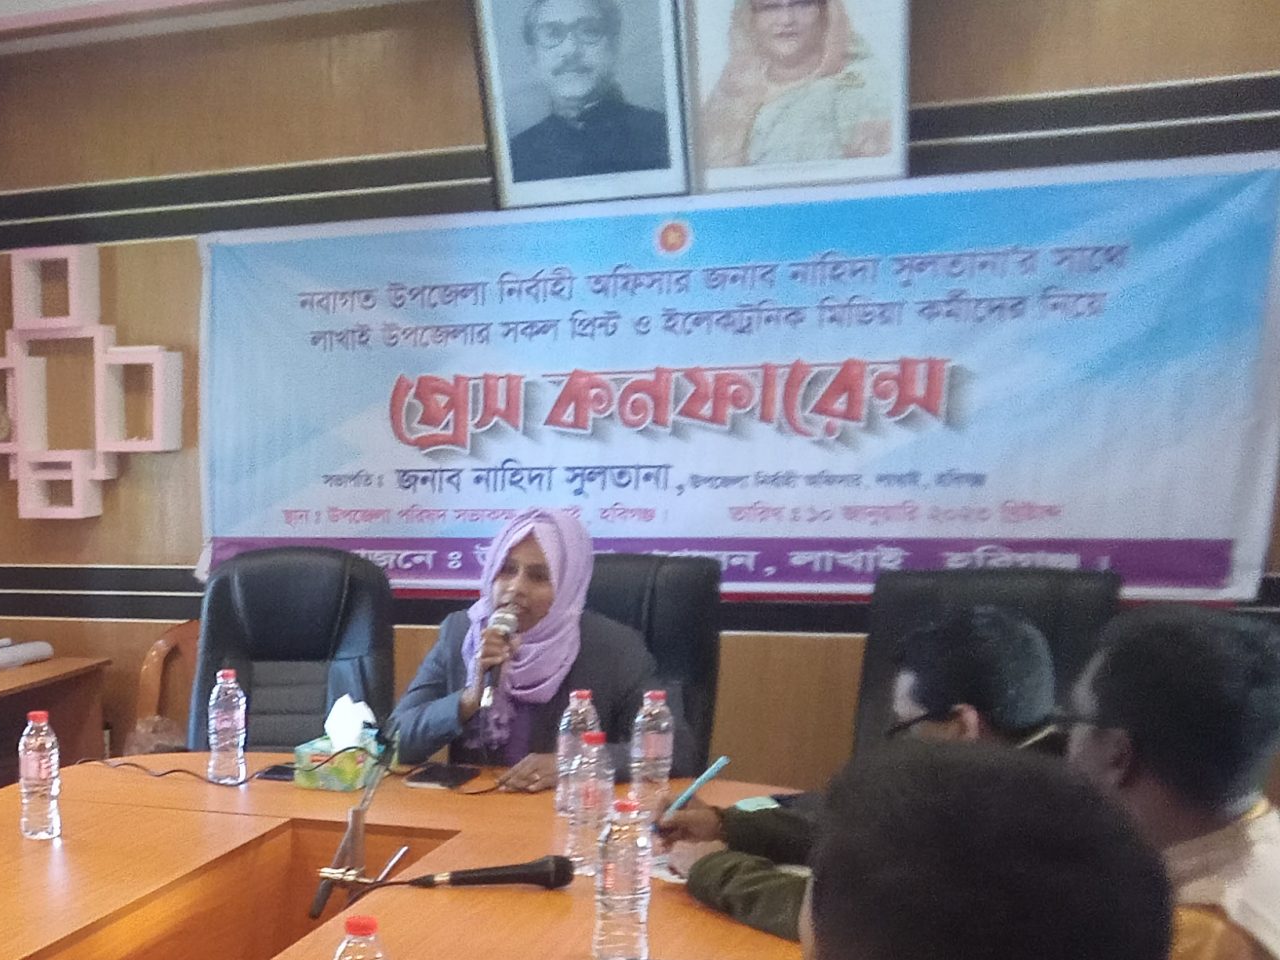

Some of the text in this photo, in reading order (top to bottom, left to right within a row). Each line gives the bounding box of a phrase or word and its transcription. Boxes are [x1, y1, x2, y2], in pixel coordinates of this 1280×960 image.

[387, 281, 489, 308] উপজেলা
[496, 267, 577, 304] নির্বাহী
[585, 263, 692, 299] অফিসার
[702, 264, 778, 290] জনাব
[788, 250, 882, 287] নাহিদা
[309, 323, 374, 352] লাখাই
[383, 320, 493, 348] উপজেলার
[499, 318, 560, 342] সকল
[570, 309, 622, 338] প্রিন্ট
[635, 315, 651, 336] ও
[816, 294, 906, 326] মিডিয়া
[389, 357, 952, 453] প্রেস কনফারেন্স
[395, 468, 465, 494] জনাব
[471, 459, 556, 493] নাহিদা
